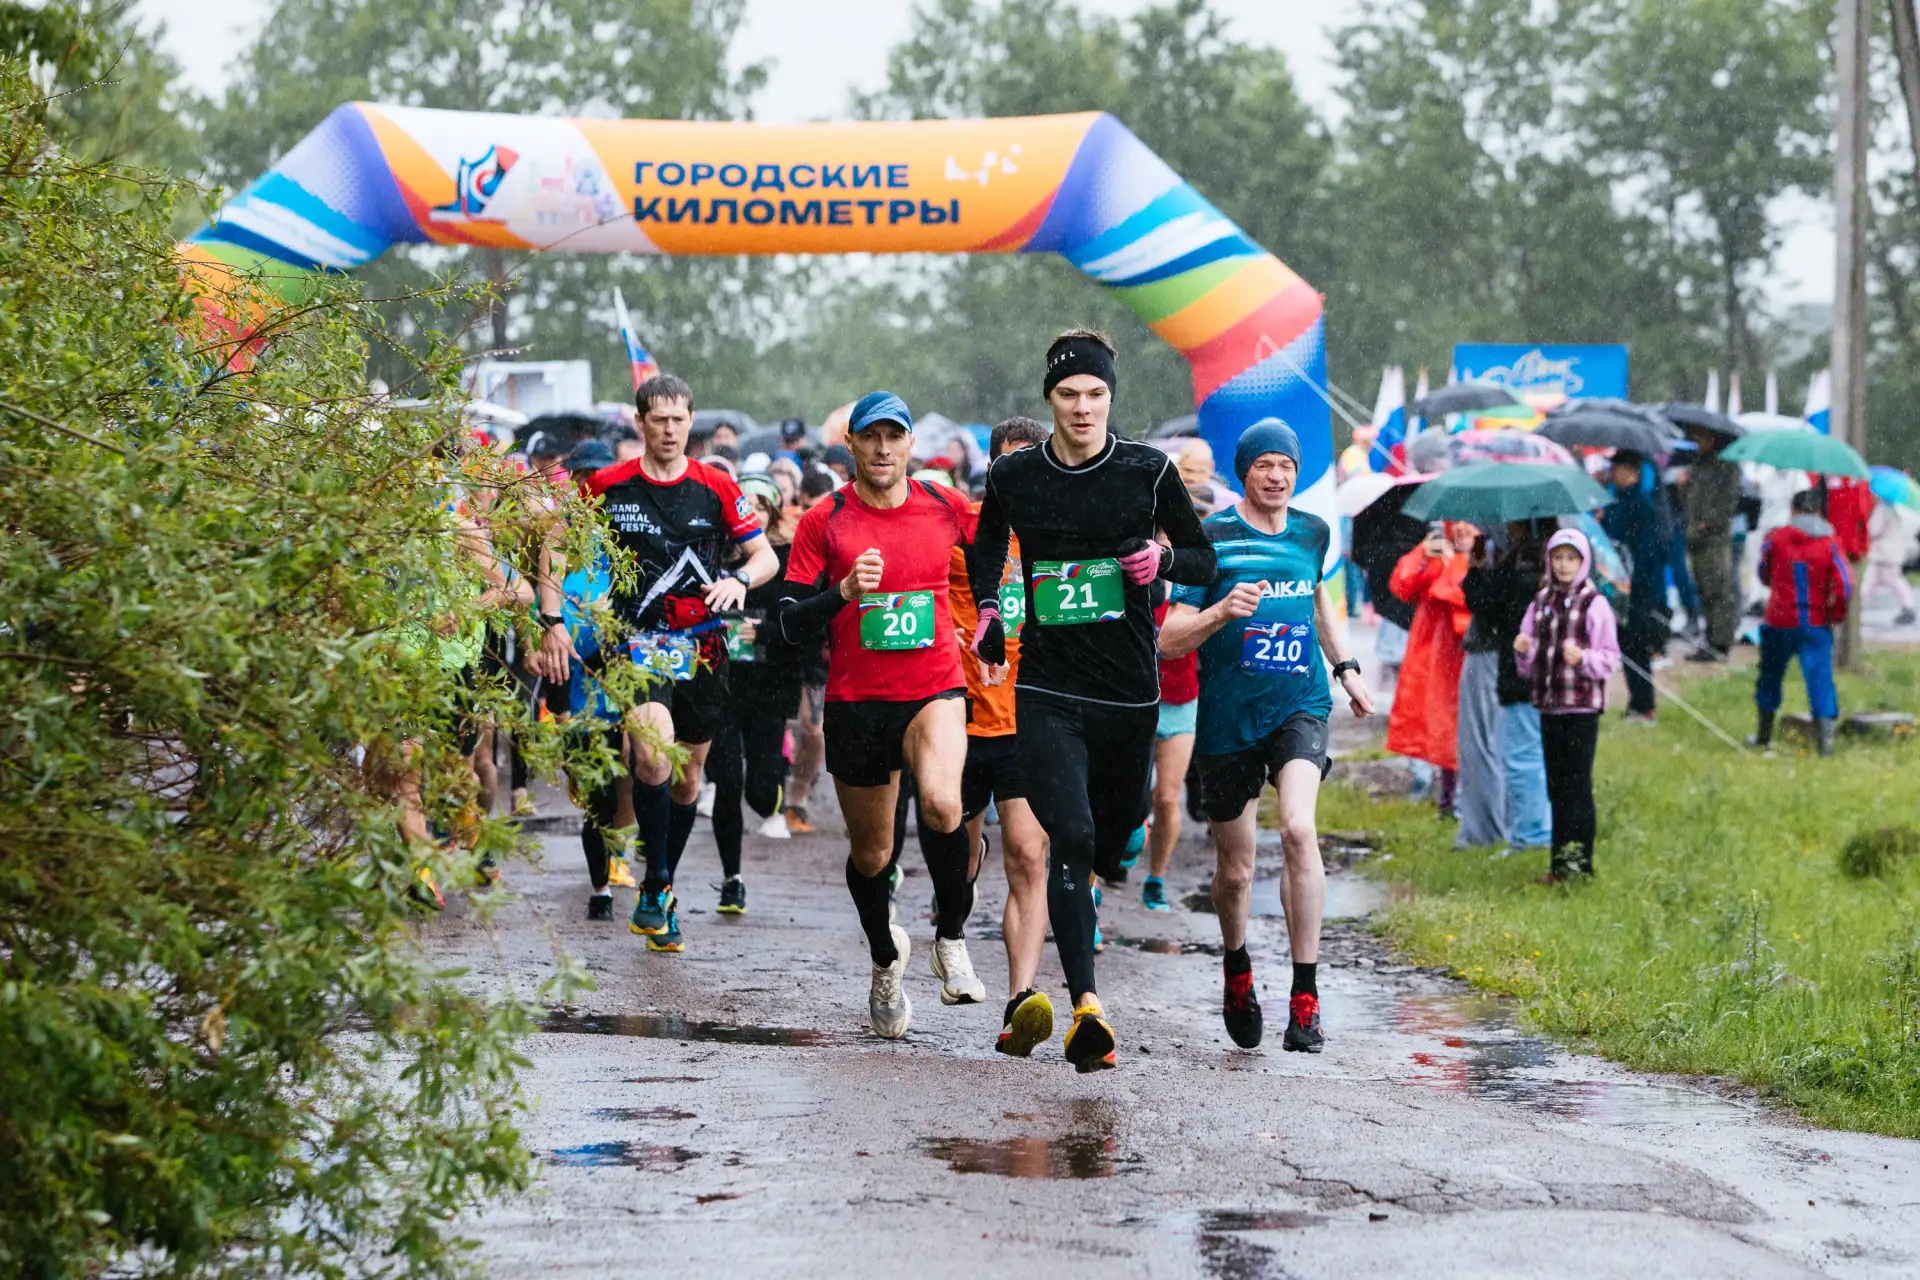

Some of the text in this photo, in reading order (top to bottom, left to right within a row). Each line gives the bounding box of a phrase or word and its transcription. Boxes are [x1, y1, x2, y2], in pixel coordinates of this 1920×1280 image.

[635, 162, 910, 192] ГОРОДСКИЕ
[634, 196, 960, 225] КИЛОМЕТРЫ
[1057, 582, 1099, 610] 21
[1260, 580, 1315, 599] AIKAL
[883, 611, 918, 637] 20
[1255, 638, 1302, 662] 210
